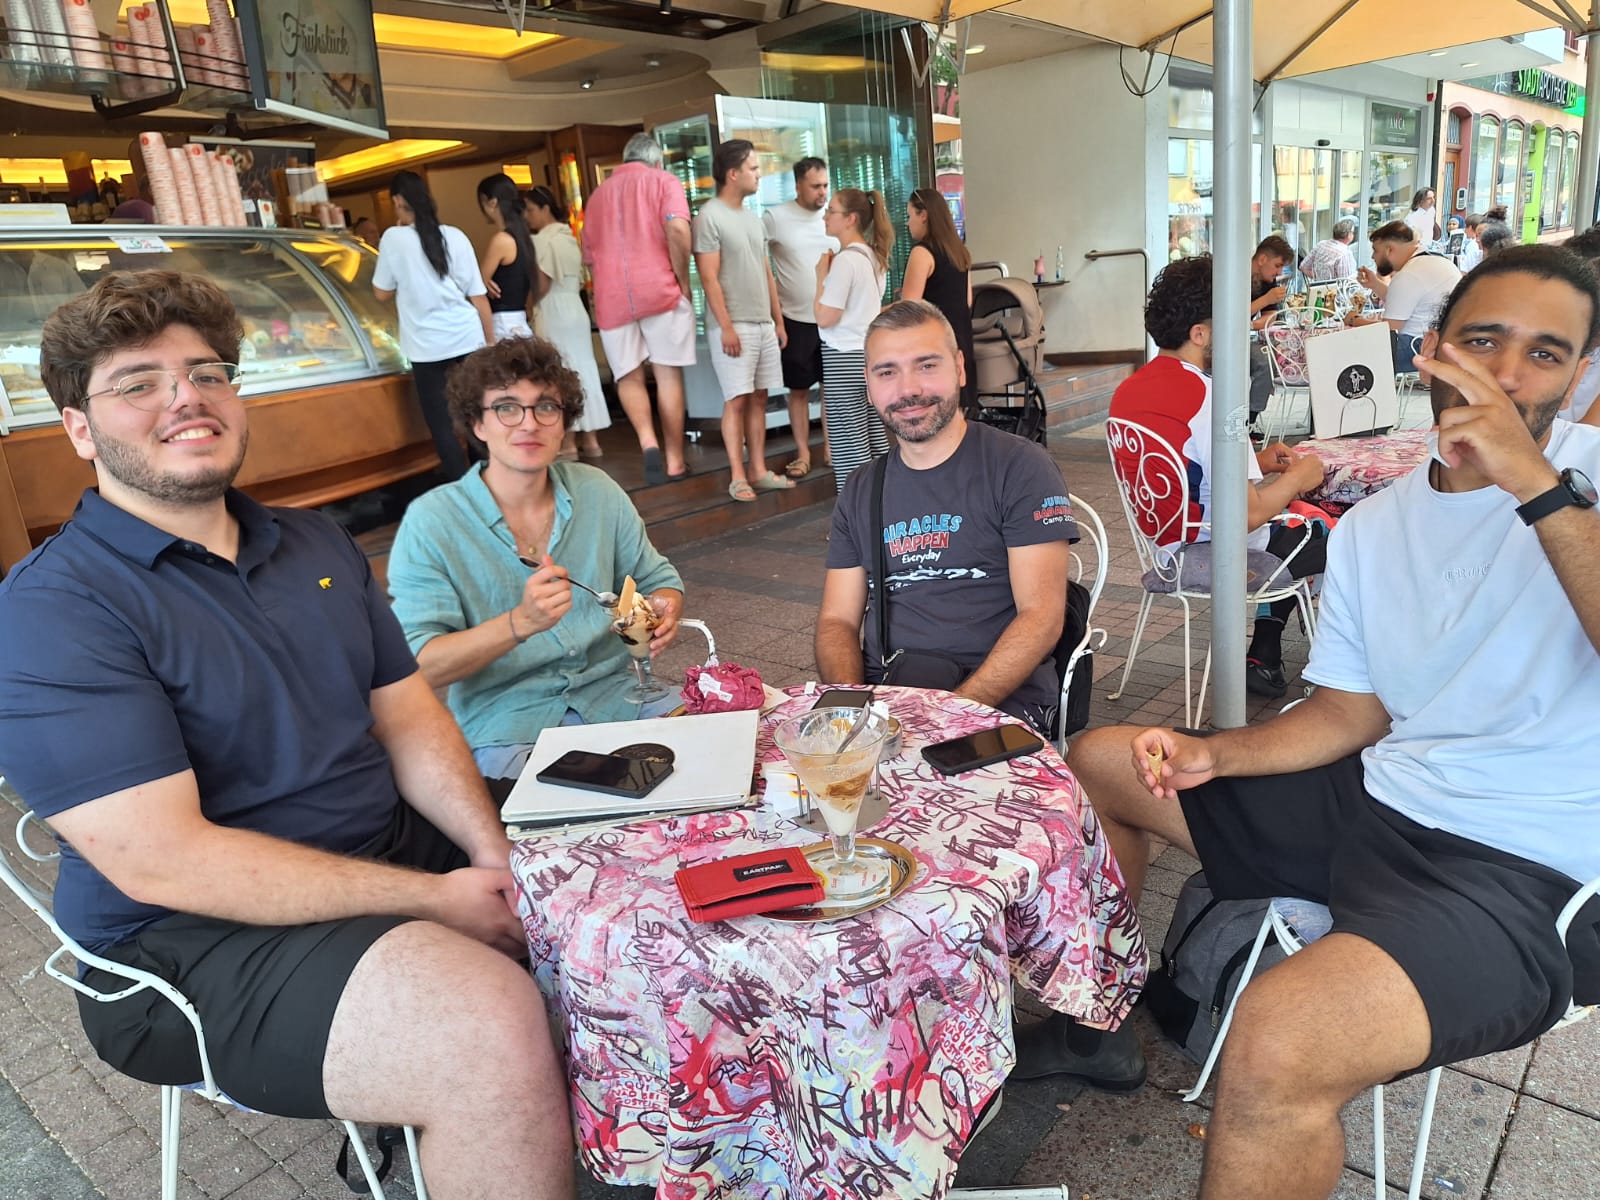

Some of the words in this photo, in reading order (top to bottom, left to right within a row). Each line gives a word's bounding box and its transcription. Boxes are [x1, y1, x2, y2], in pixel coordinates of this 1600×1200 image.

[280, 11, 350, 57] Frühstück
[1042, 515, 1064, 525] Camp
[890, 531, 950, 557] HAPPEN
[902, 549, 942, 564] Everyday
[743, 863, 785, 876] EASTPAK
